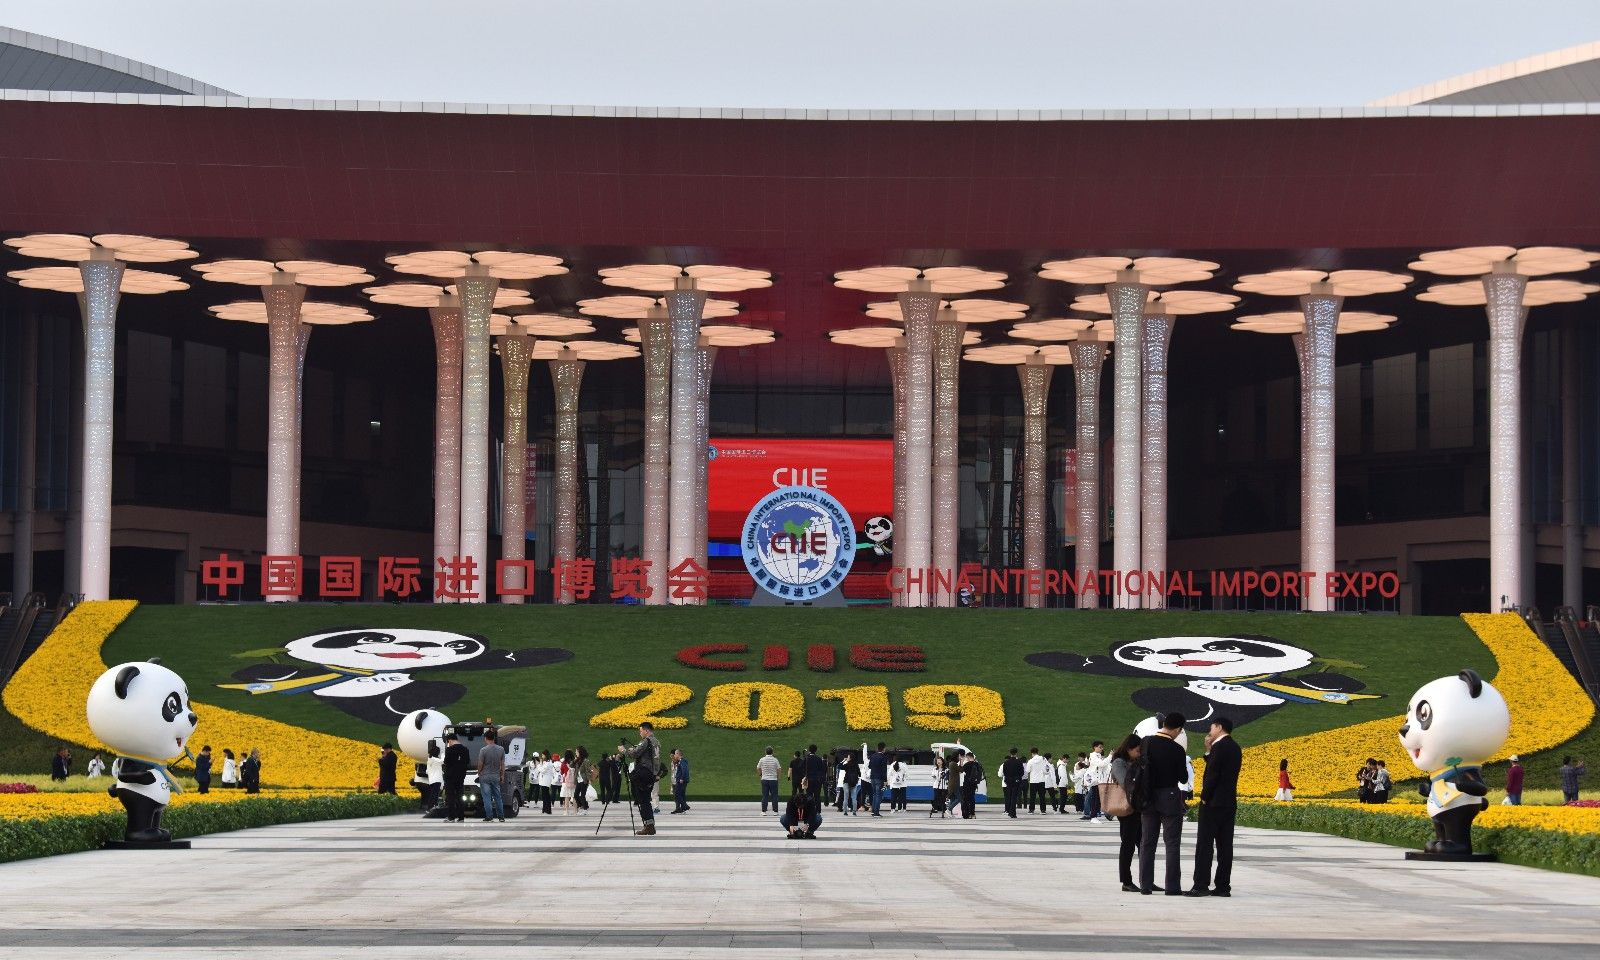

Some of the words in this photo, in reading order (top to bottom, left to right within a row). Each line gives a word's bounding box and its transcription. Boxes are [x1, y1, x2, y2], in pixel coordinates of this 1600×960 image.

[772, 467, 828, 489] CIIE
[747, 522, 758, 550] CHINA
[753, 491, 819, 525] INTERNATIONAL
[819, 497, 847, 526] IMPORT
[841, 525, 852, 551] EXPO
[771, 532, 827, 555] CIIE
[202, 553, 712, 601] 中国国际进口博览会
[885, 566, 973, 594] CHINA
[981, 568, 1202, 597] INTERNATIONAL
[1210, 570, 1316, 598] IMPORT
[1325, 571, 1400, 599] EXPO
[675, 642, 928, 673] CIIE
[588, 681, 1007, 733] 2019
